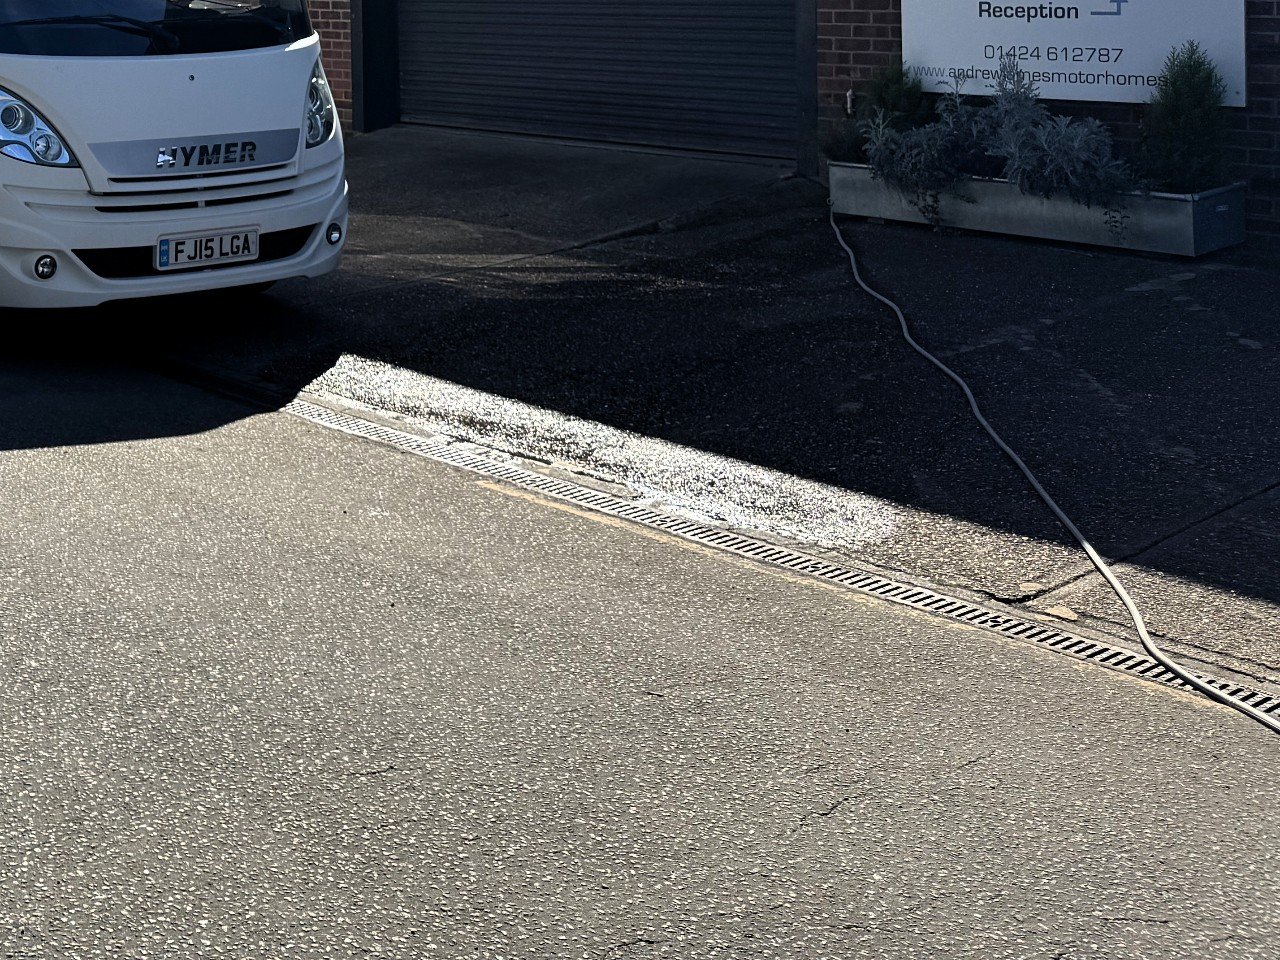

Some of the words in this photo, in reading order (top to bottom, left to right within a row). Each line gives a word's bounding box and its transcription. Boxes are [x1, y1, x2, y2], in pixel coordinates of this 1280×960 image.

[978, 1, 1079, 22] Reception
[984, 44, 1042, 61] 01424
[1046, 46, 1124, 63] 612787
[913, 65, 1169, 87] www.andrewmesmotorhomes
[156, 141, 257, 168] HYMER
[174, 238, 215, 262] FJ15
[219, 233, 251, 257] LGA
